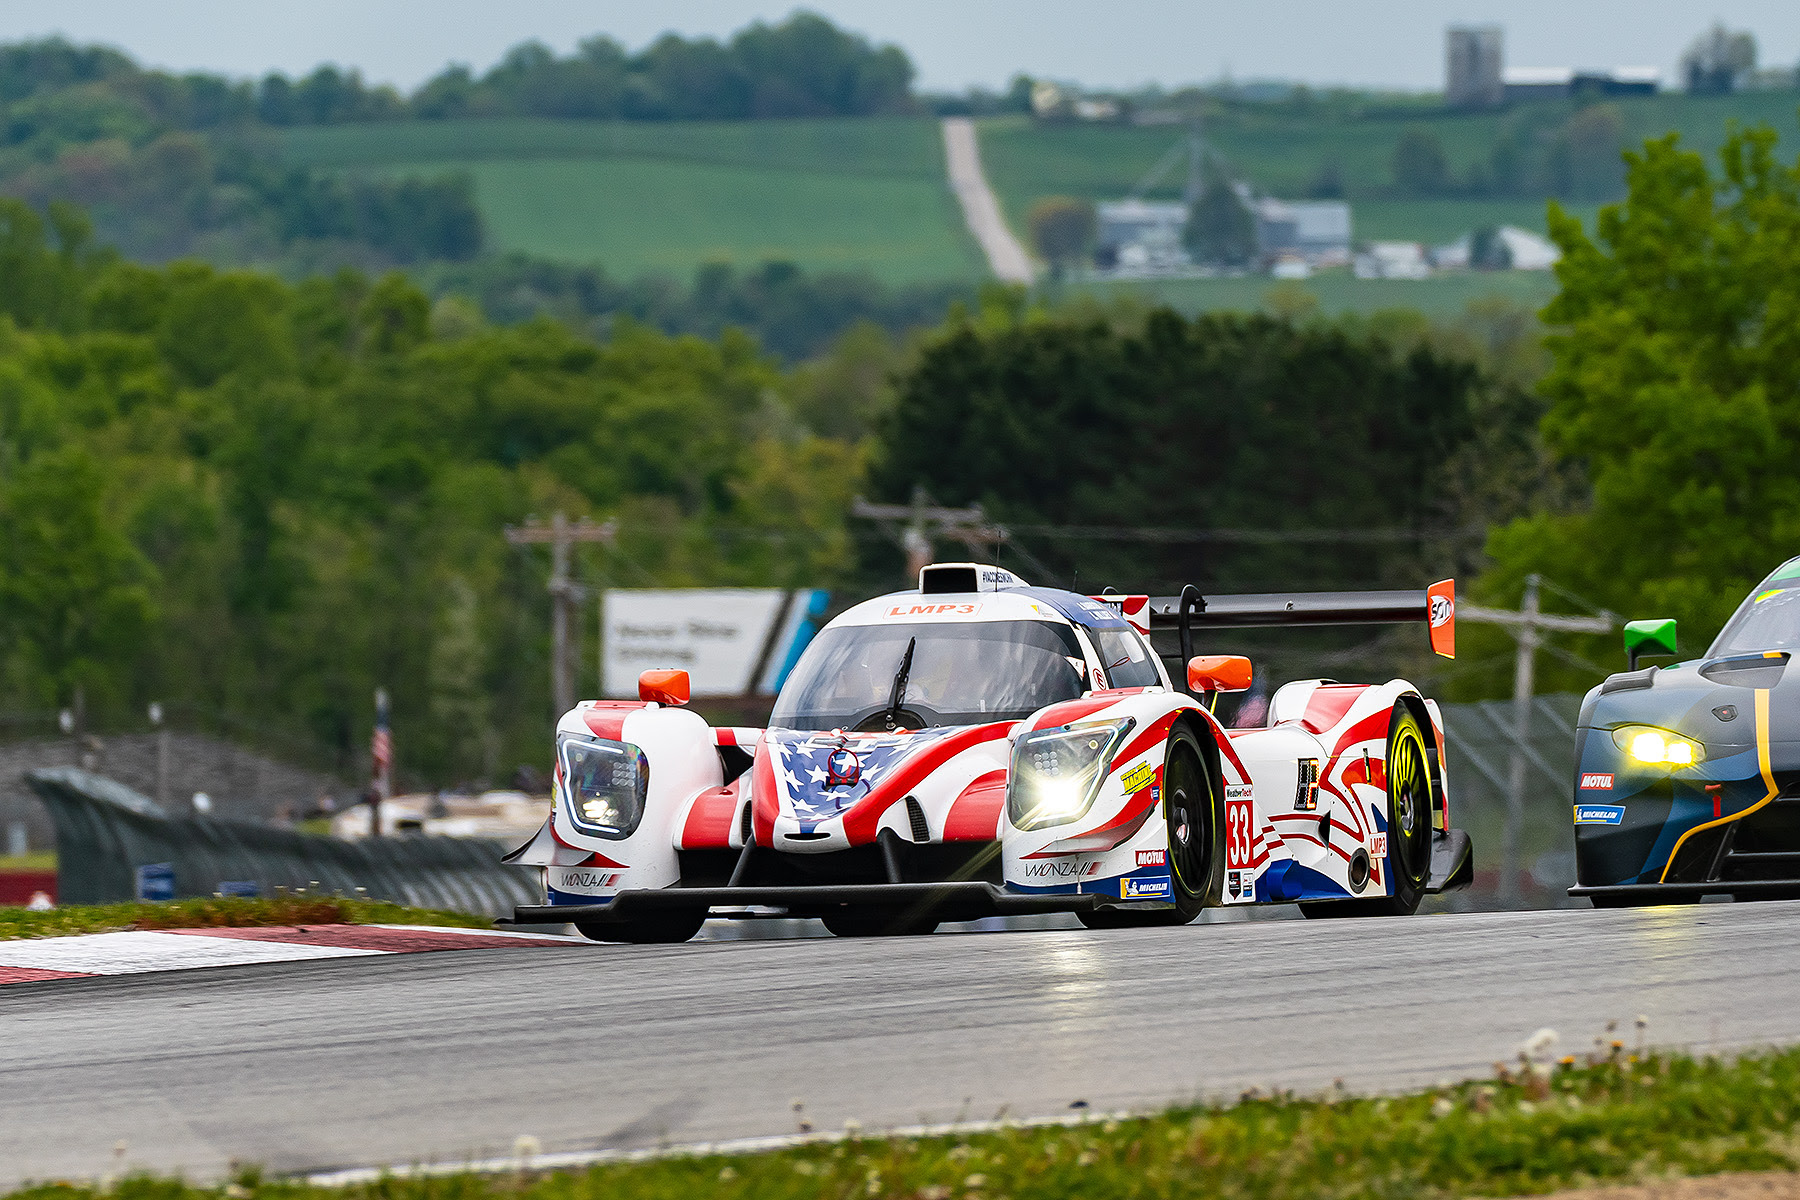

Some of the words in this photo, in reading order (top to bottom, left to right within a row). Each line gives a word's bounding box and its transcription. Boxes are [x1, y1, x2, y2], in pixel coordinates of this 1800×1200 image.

[889, 604, 975, 617] LMP3
[1581, 775, 1612, 788] MOTUL
[1582, 810, 1618, 819] MICHELIN
[1229, 804, 1250, 866] 33
[1370, 836, 1386, 855] LMP3
[1137, 851, 1165, 866] MOTUL
[1138, 882, 1168, 893] MICHELIN
